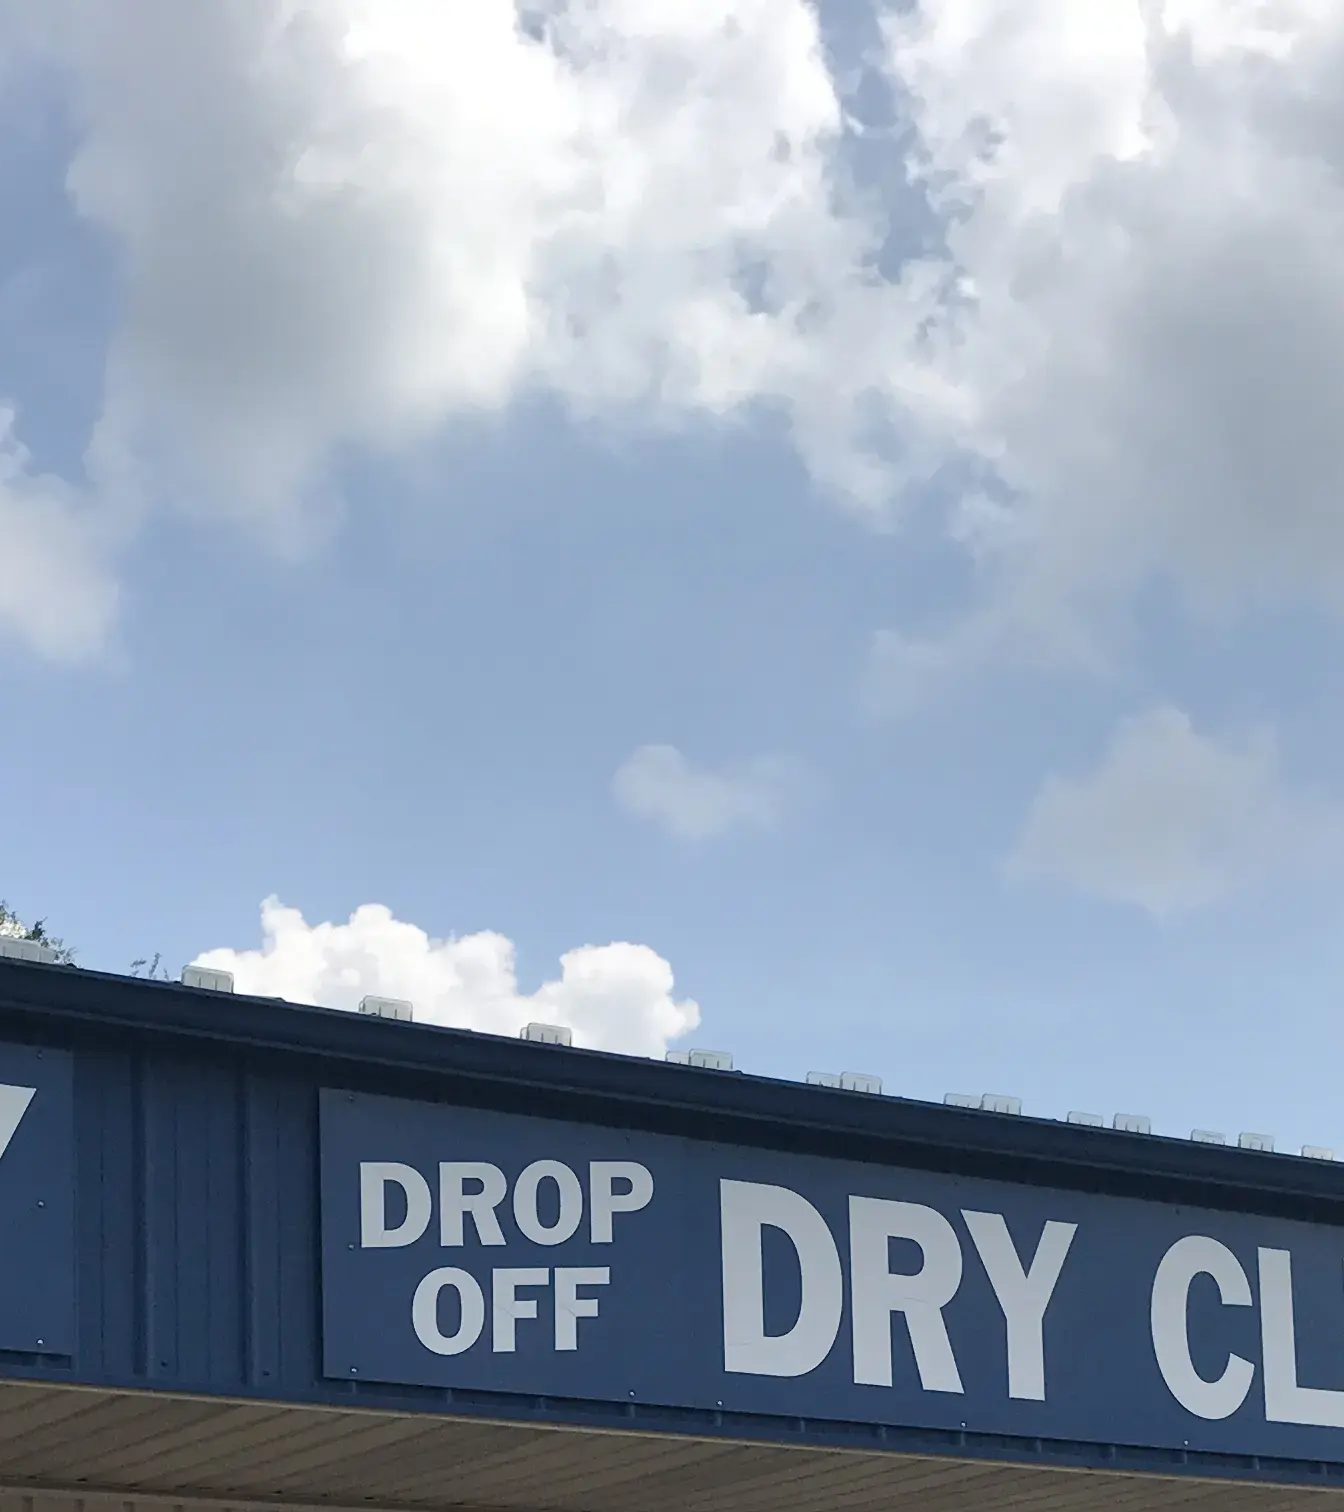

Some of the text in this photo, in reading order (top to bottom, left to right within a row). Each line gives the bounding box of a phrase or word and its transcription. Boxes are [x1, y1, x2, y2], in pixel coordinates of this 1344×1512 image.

[359, 1159, 654, 1249] DROP
[411, 1266, 612, 1357] OFF
[718, 1178, 1077, 1402] DRY
